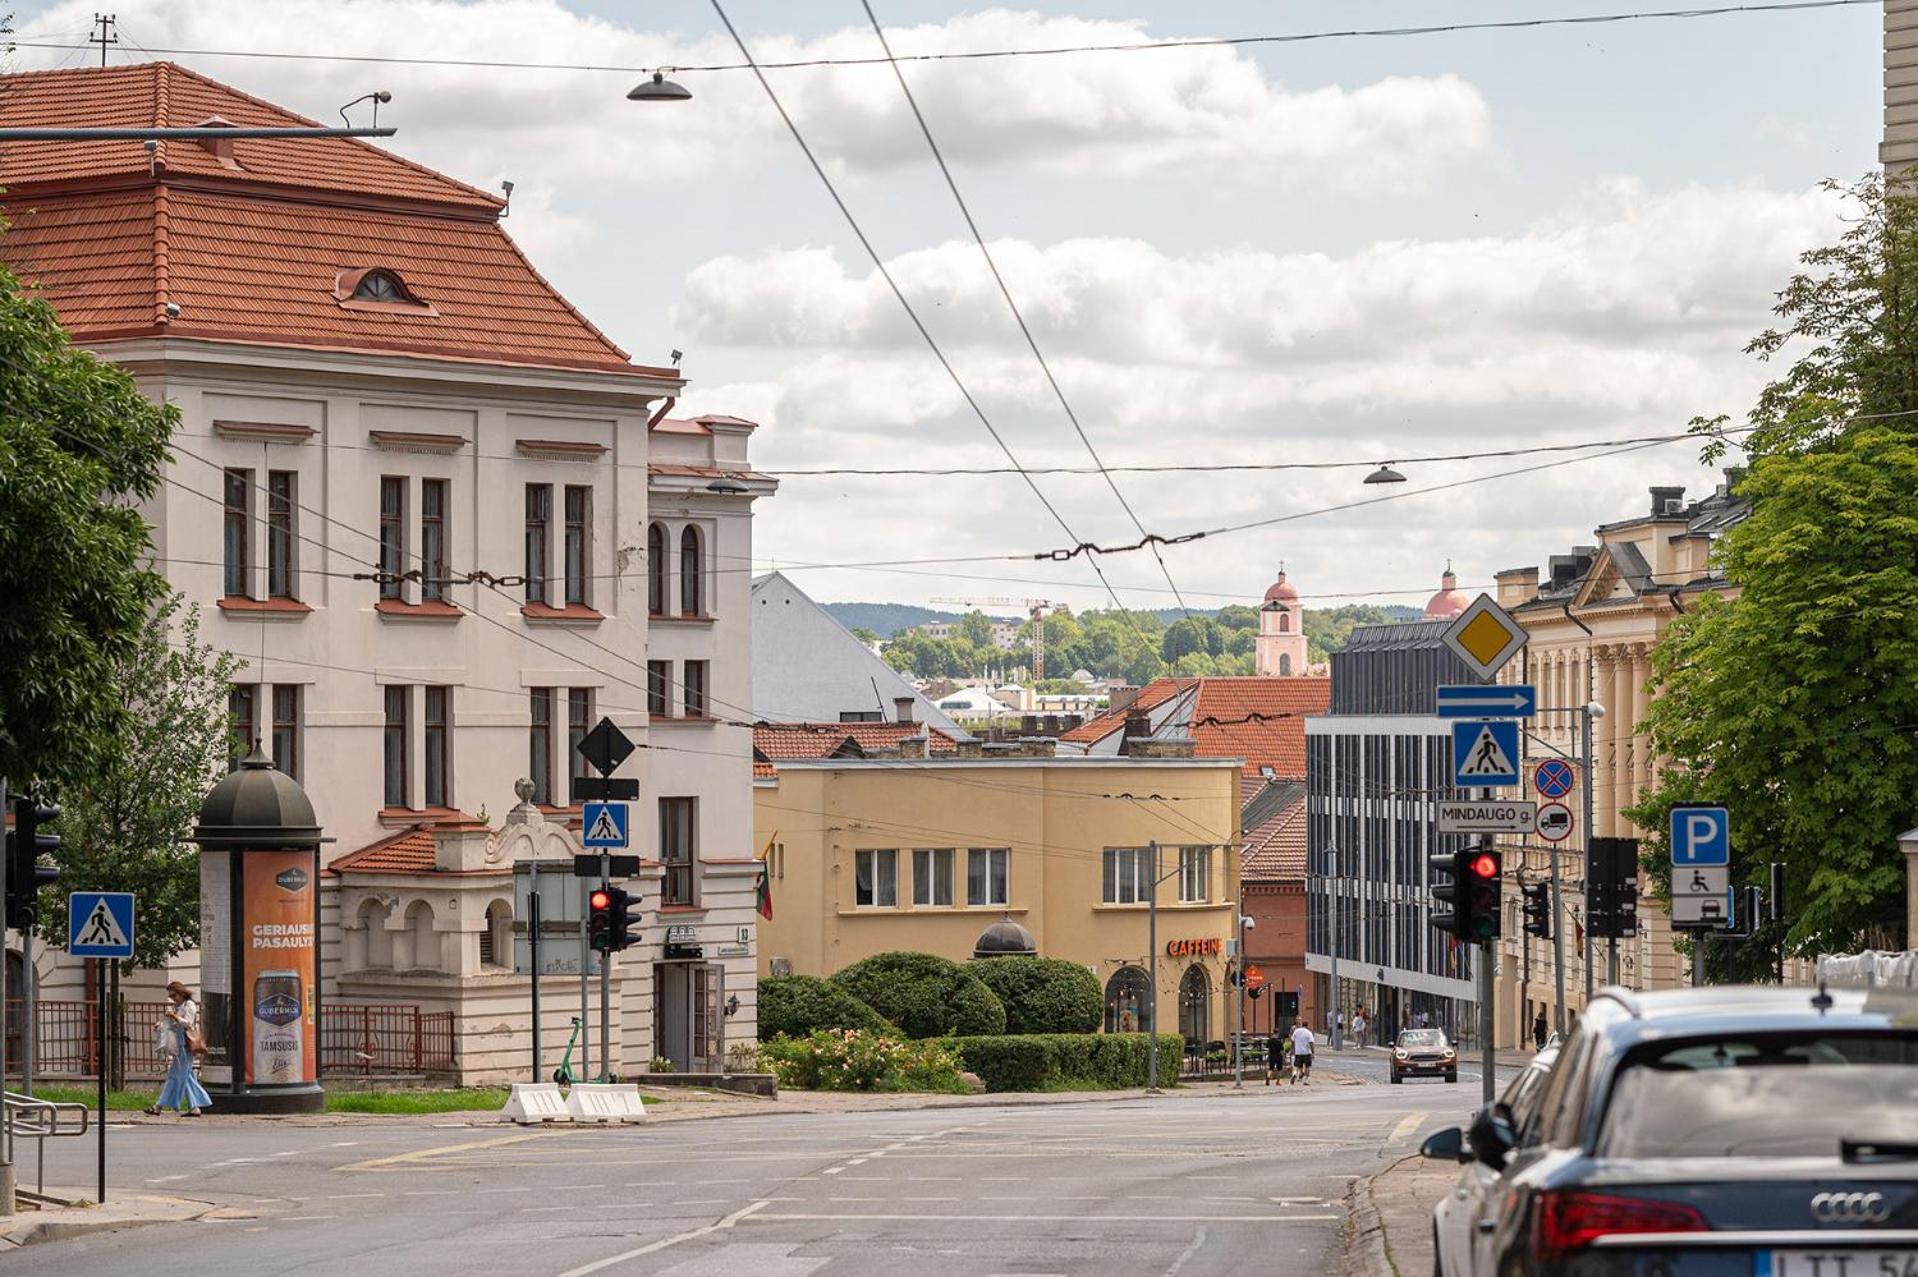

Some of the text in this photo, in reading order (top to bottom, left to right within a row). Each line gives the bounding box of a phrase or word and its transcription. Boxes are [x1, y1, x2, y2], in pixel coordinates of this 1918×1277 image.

[1442, 807, 1532, 824] MINDAUGO g.
[1687, 815, 1718, 859] P
[1167, 938, 1223, 957] CAFFEINE
